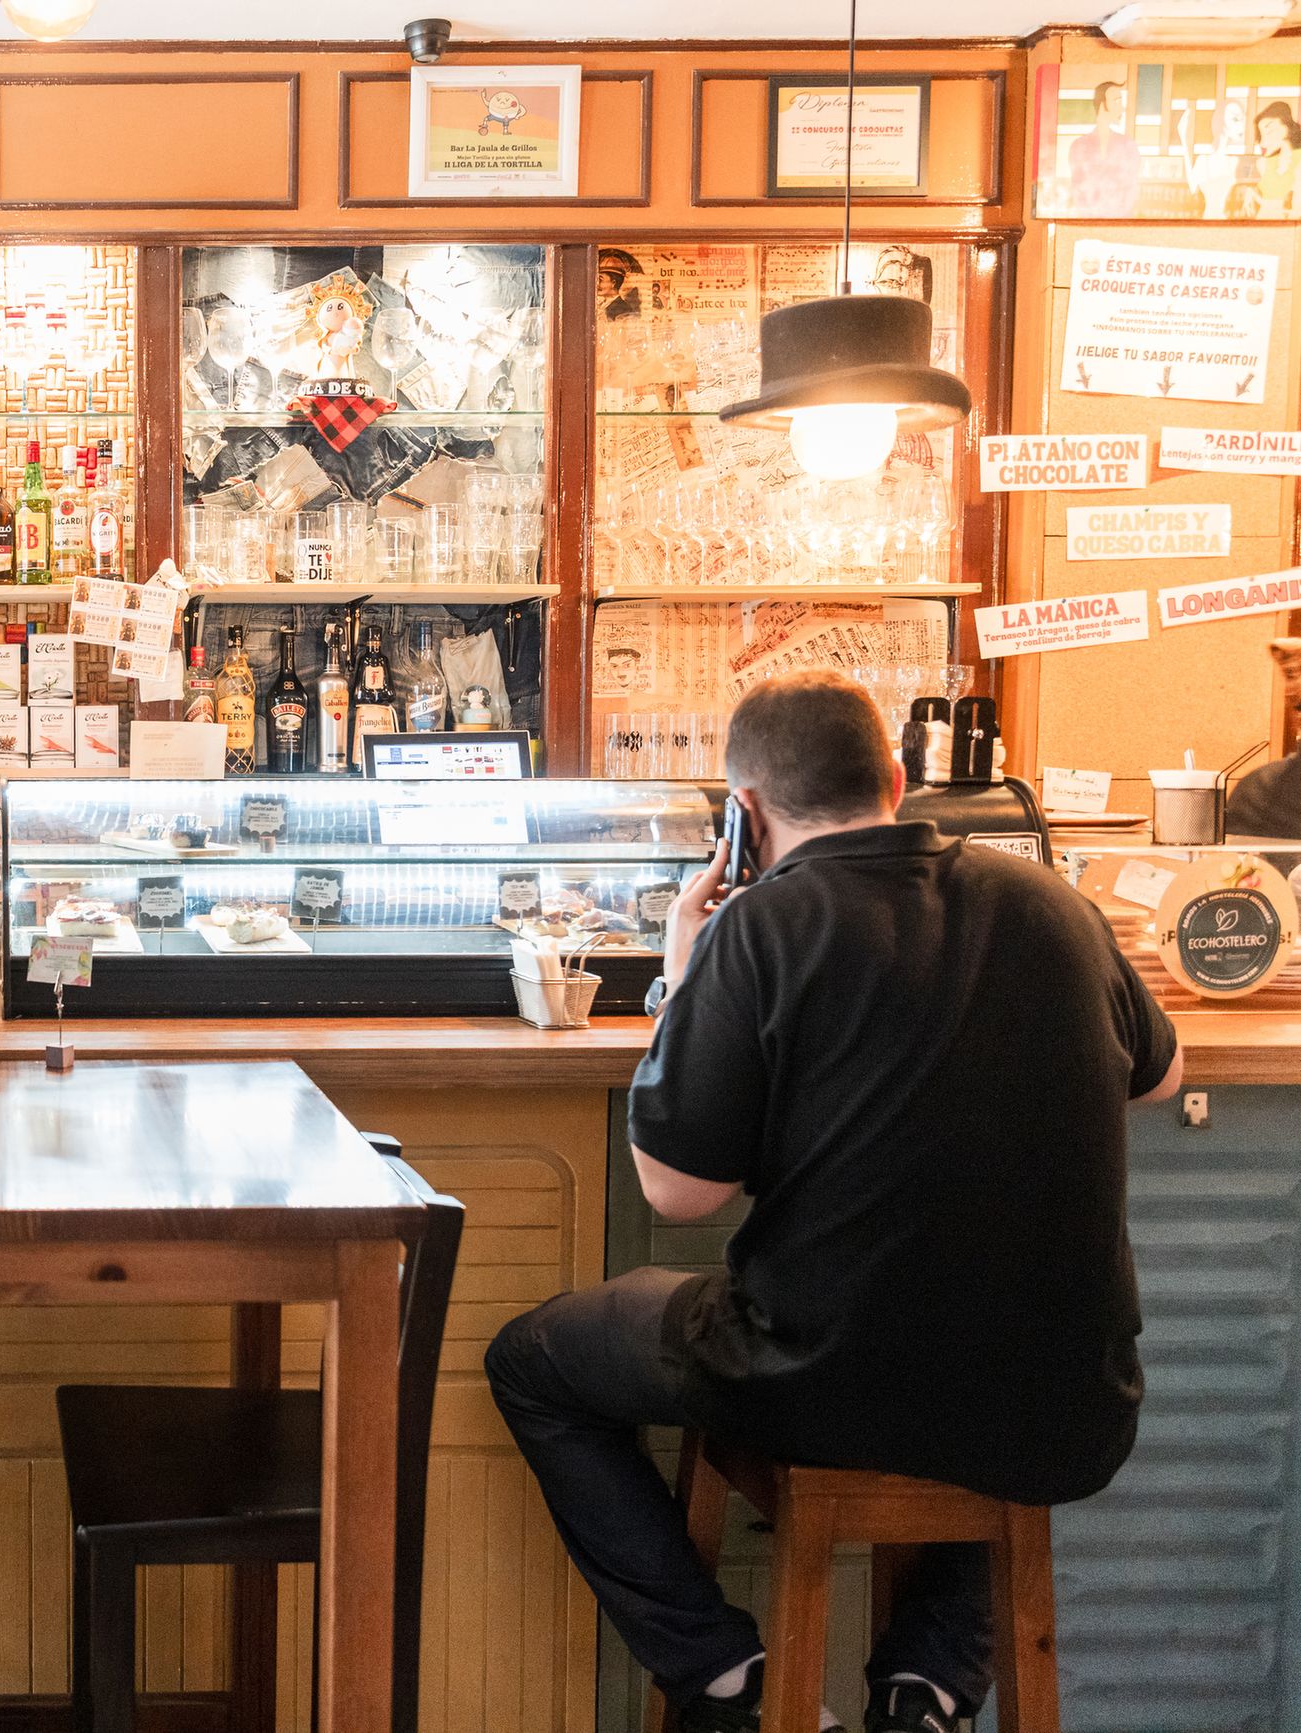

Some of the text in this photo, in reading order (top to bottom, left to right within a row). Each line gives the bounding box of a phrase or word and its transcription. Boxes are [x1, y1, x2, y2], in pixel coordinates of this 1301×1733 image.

[802, 126, 844, 134] CONCURSO
[450, 144, 464, 152] Bar
[477, 144, 498, 153] Jaula
[500, 144, 509, 152] de
[511, 144, 538, 152] Grillos
[1105, 255, 1265, 282] ÉSTAS SON NUESTRAS
[1081, 278, 1240, 300] CROQUETAS CASERAS
[1124, 348, 1139, 360] TU
[1143, 350, 1184, 362] SABOR
[328, 381, 352, 395] DE
[1096, 440, 1140, 461] CON
[1227, 453, 1256, 464] curry
[999, 463, 1129, 485] CHOCOLATE
[1088, 511, 1210, 533] CHAMPIS Y
[1073, 534, 1222, 557] QUESO CABRA
[308, 554, 323, 566] TE
[308, 568, 333, 581] DIJE
[1167, 579, 1301, 618] LONGANI
[1002, 608, 1032, 629] LA
[984, 631, 1027, 642] Ternasco
[1074, 622, 1100, 634] queso
[1113, 615, 1141, 626] cabra
[1022, 635, 1063, 646] confitura
[1064, 634, 1075, 642] de
[1076, 629, 1111, 641] borraja
[221, 712, 252, 721] TERRY
[273, 704, 305, 715] BAILEYS
[1187, 934, 1268, 950] ECOHOSTELERO
